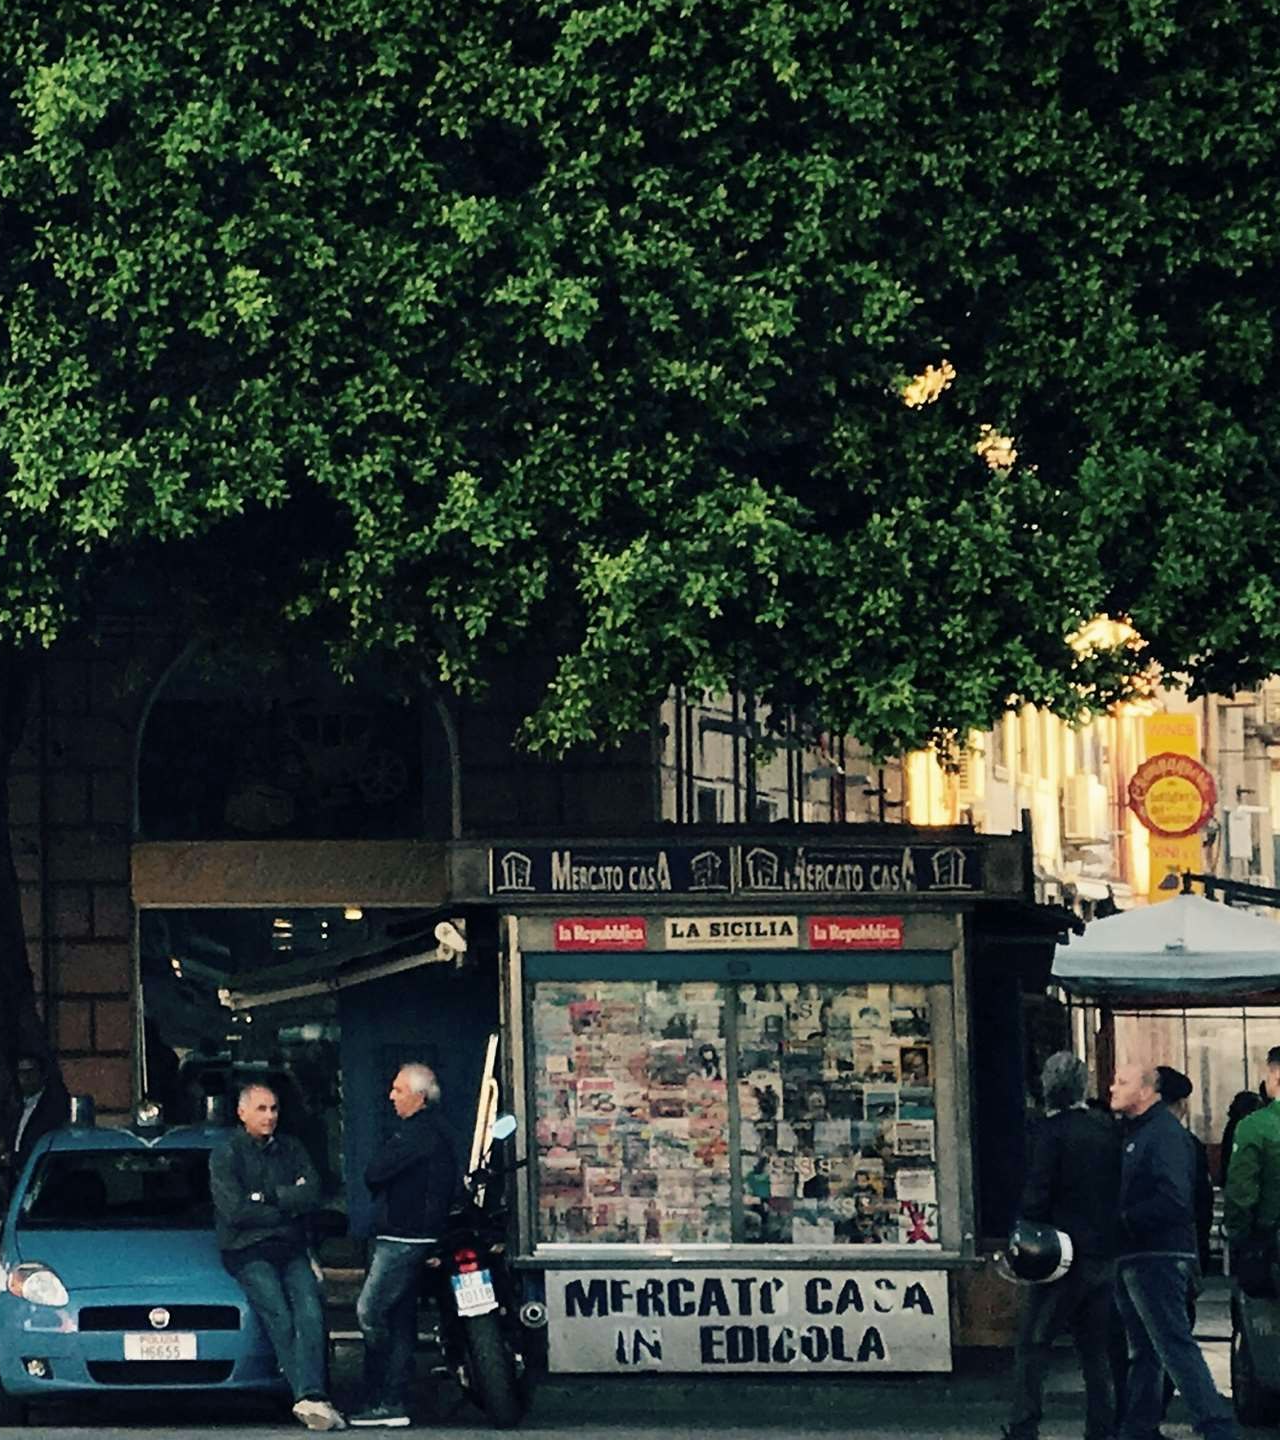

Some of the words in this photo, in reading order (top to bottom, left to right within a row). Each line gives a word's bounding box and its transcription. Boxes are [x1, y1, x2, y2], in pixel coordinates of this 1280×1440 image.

[558, 925, 572, 941] la
[573, 924, 644, 944] Repubblica
[671, 922, 700, 938] LA
[709, 921, 794, 938] SICILIA
[813, 924, 828, 941] la
[829, 924, 901, 944] Repubblica
[615, 1328, 663, 1365] IN
[699, 1324, 887, 1365] EDICOLA
